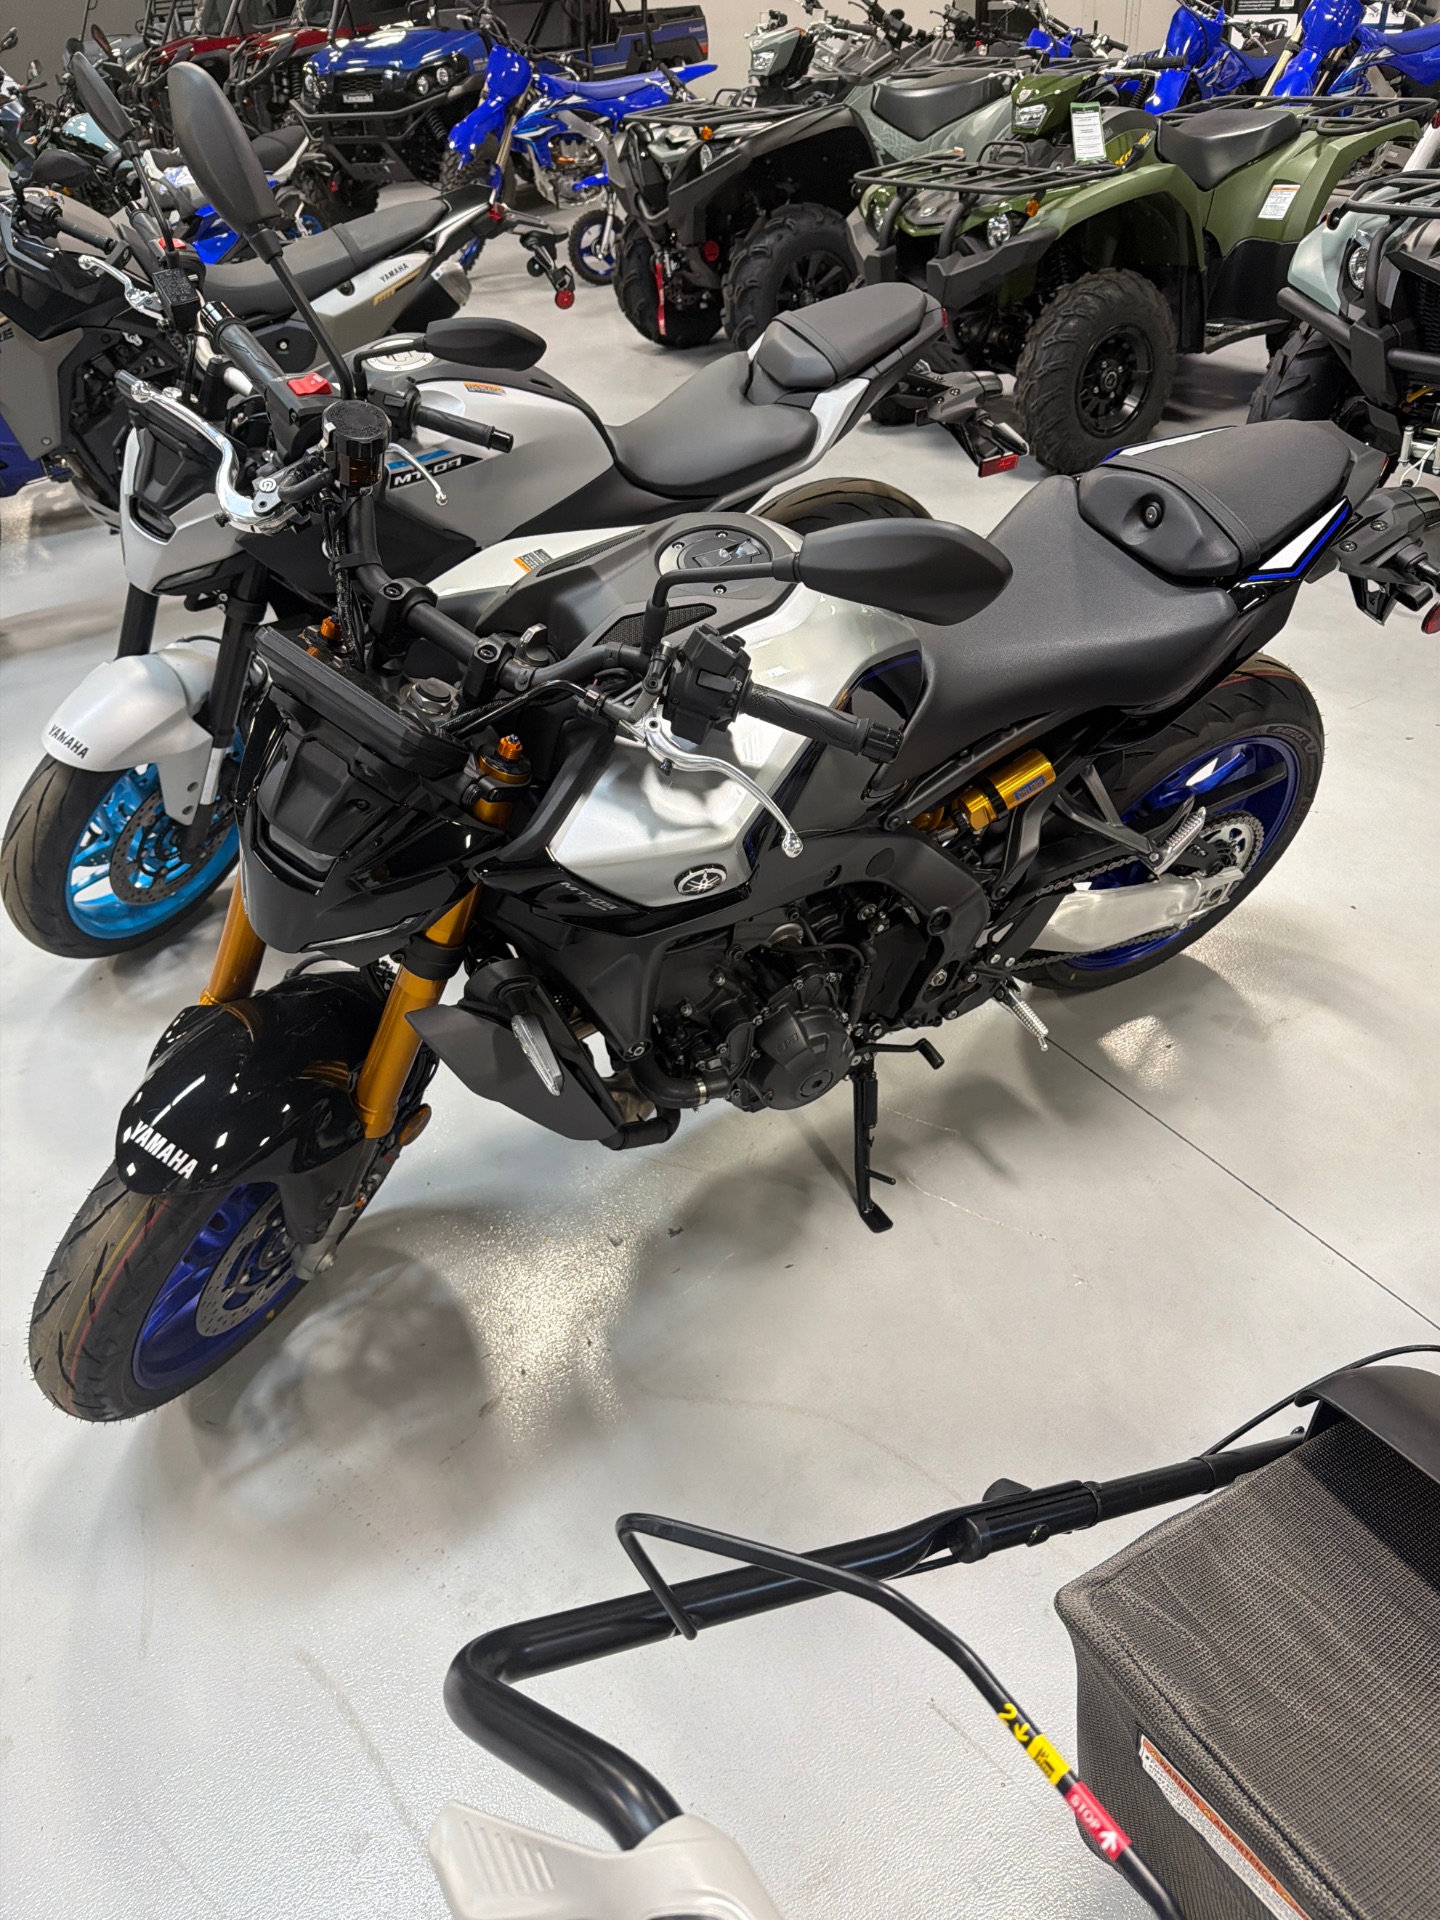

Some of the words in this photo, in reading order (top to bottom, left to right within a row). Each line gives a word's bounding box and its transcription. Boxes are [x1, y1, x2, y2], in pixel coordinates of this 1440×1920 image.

[380, 262, 409, 283] YAMAHA
[394, 457, 462, 486] MT-07
[48, 724, 90, 759] YAMAHA
[130, 1120, 199, 1179] YAMAHA
[998, 1703, 1017, 1727] 2
[1159, 1759, 1199, 1805] WARNING
[1070, 1793, 1101, 1829] STOP
